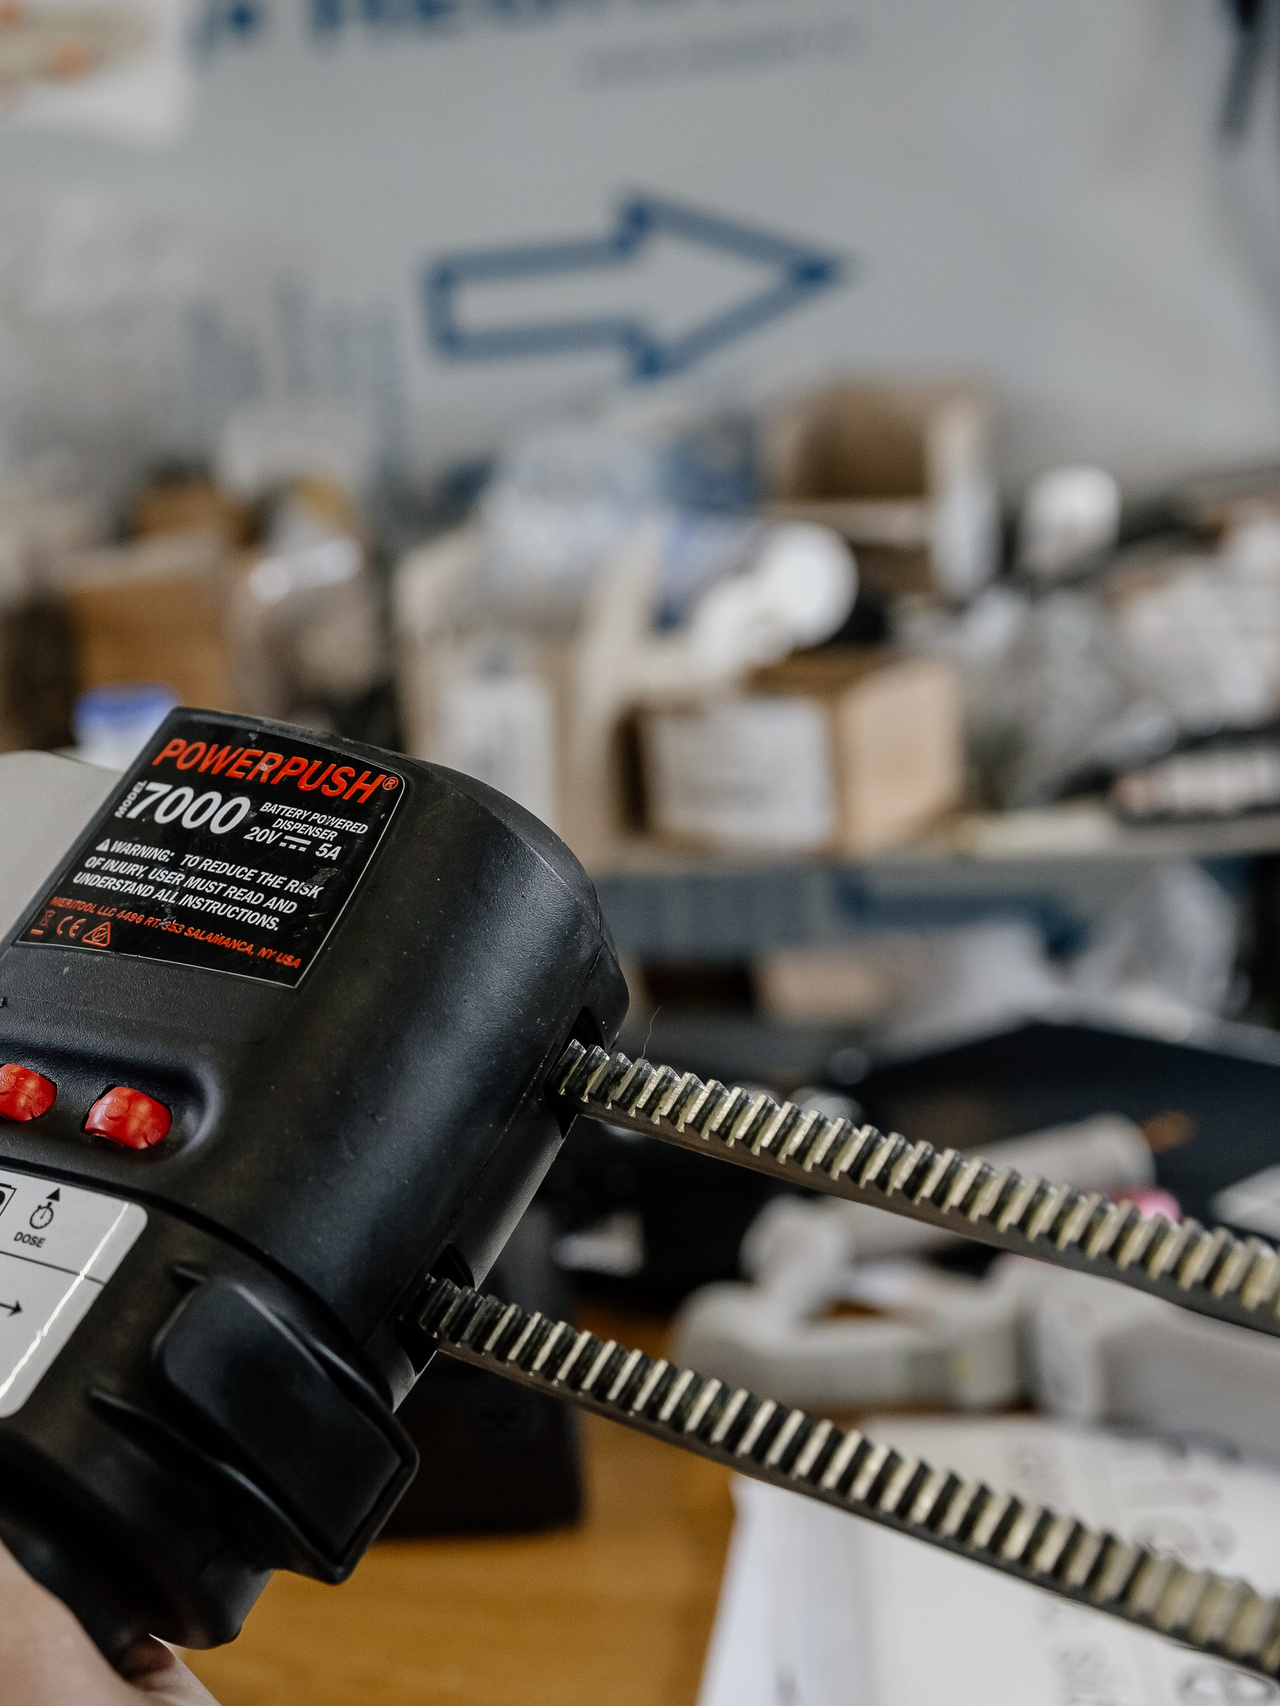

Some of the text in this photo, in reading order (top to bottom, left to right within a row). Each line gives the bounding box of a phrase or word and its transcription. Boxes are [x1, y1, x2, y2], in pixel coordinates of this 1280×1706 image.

[115, 780, 251, 834] MODEL 7000
[259, 802, 369, 834] BATTERY POWERED
[272, 818, 338, 841] DISPENSER
[110, 840, 324, 898] WARNING: TO REDUCE THE RISK
[243, 826, 342, 861] 20V 5A
[73, 871, 280, 931] UNDERSTAND ALL INSTRUCTIONS.
[84, 856, 298, 914] OF INJURY, USER MUST READ AND
[49, 896, 96, 914] MERITOOL
[96, 905, 117, 917] LLC
[116, 908, 143, 925] 4496
[184, 926, 256, 955] SALAMANCA,
[256, 946, 278, 960] NY
[275, 951, 302, 969] USA
[14, 1231, 46, 1249] DOSE
